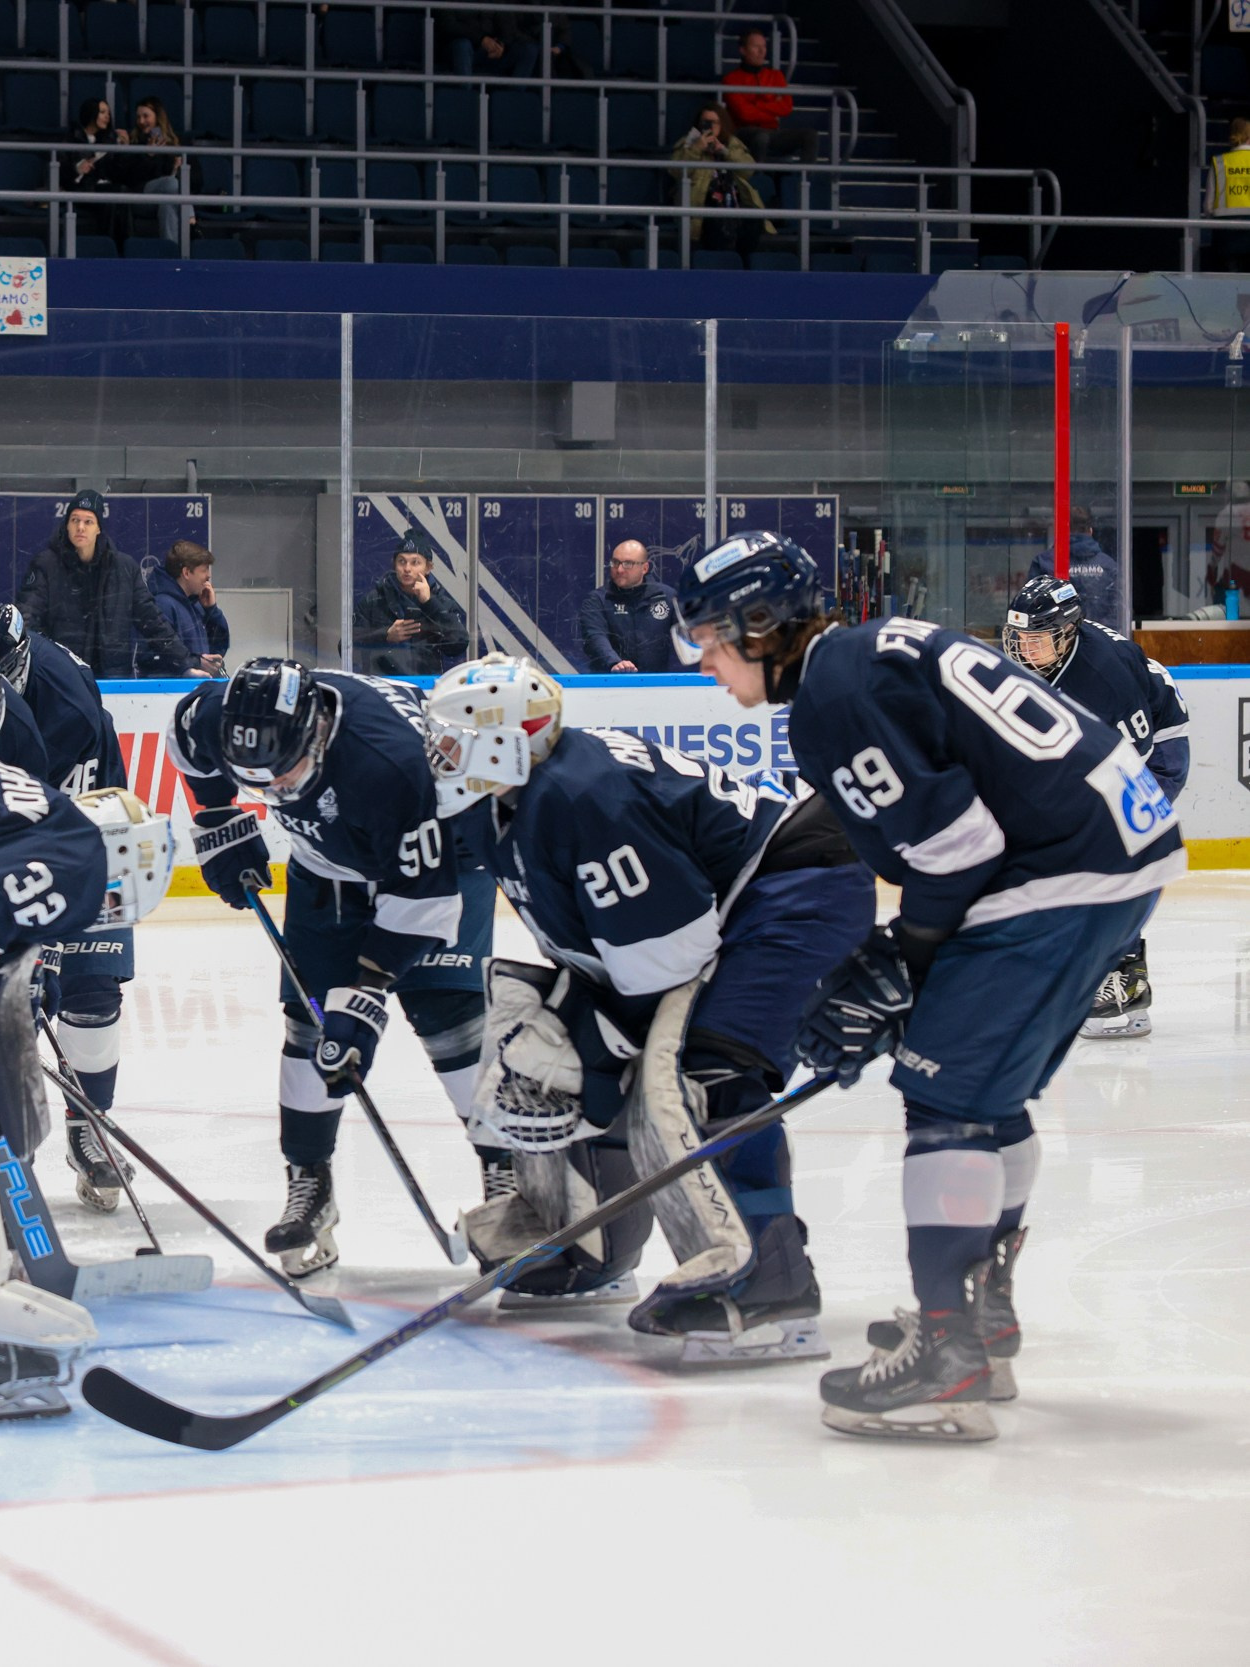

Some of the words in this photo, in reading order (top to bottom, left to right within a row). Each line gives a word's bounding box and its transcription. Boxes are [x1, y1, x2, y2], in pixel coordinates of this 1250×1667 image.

[1228, 167, 1250, 175] SAFE
[1229, 184, 1250, 196] K09
[186, 503, 203, 518] 26
[358, 503, 370, 517] 27
[446, 503, 462, 518] 28
[484, 503, 501, 518] 29
[575, 503, 592, 518] 30
[610, 503, 625, 518] 31
[730, 503, 746, 518] 33
[815, 503, 832, 518] 34
[1116, 709, 1149, 744] 18
[232, 724, 258, 749] 50
[831, 745, 905, 819] 69
[398, 819, 443, 878] 50
[577, 844, 650, 909] 20
[3, 861, 68, 928] 32
[62, 940, 124, 956] AUER
